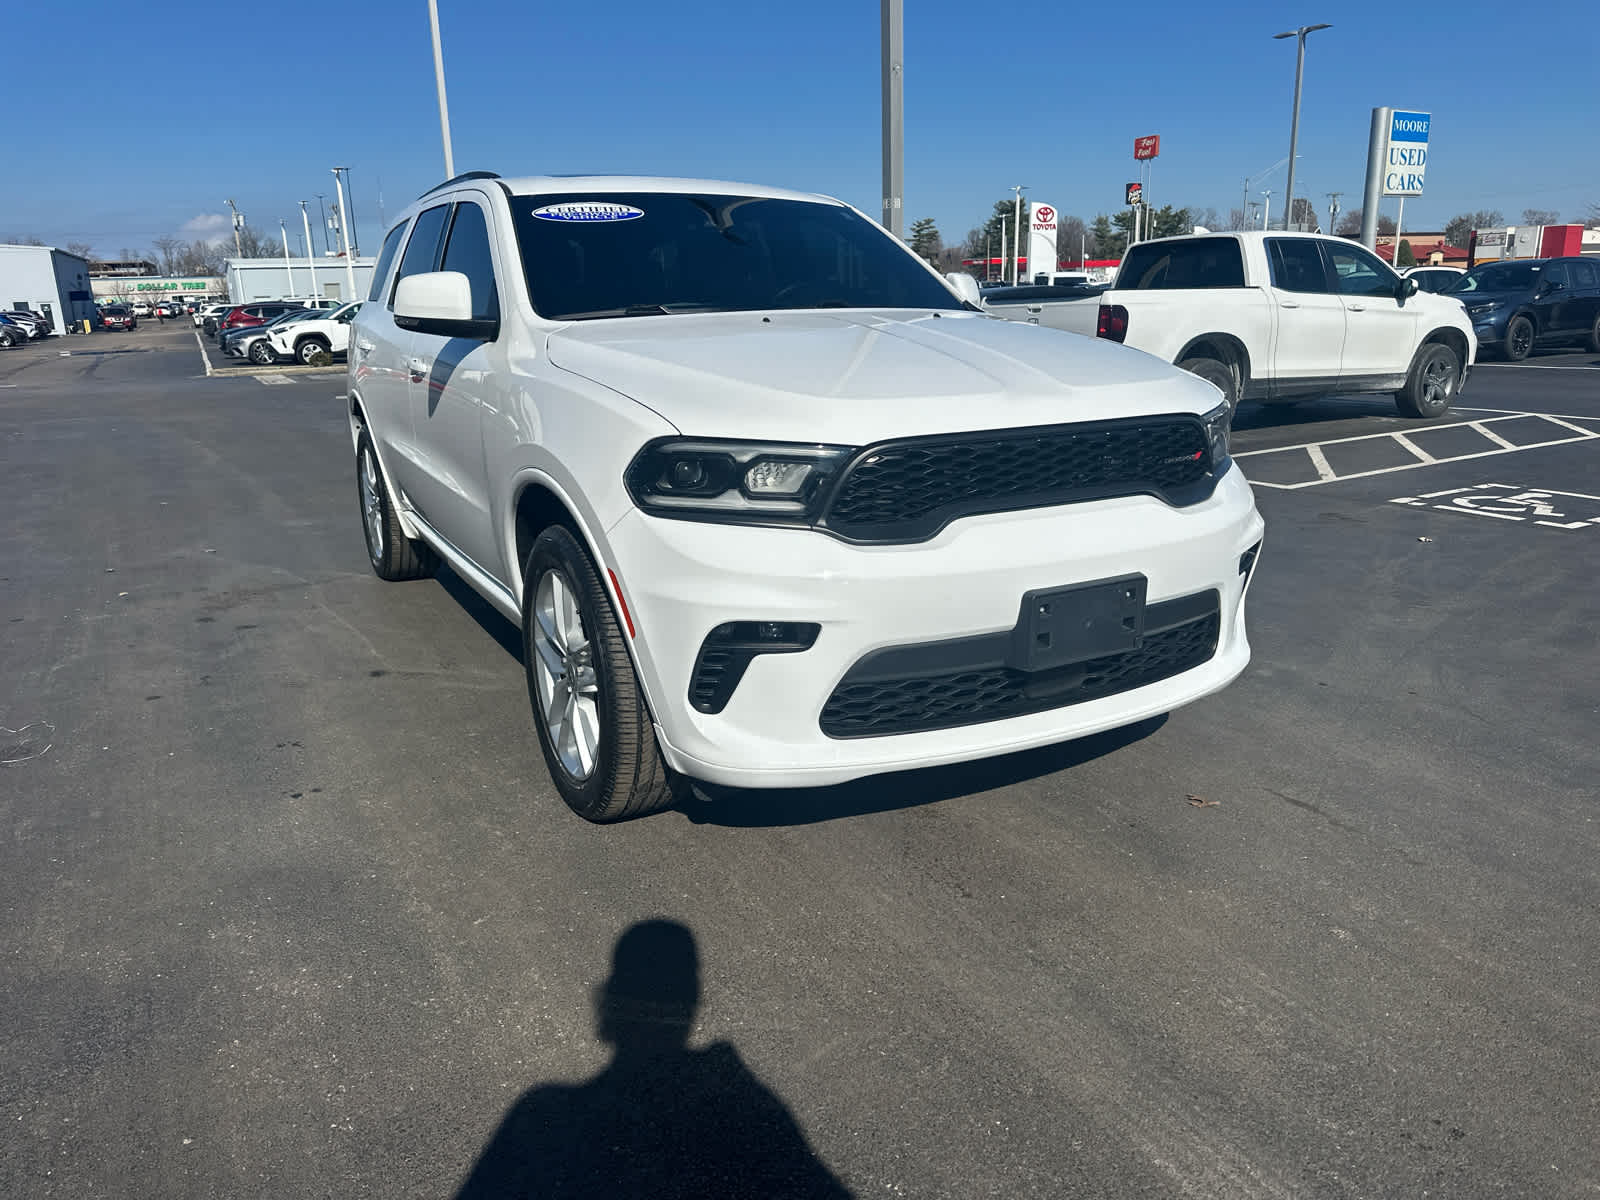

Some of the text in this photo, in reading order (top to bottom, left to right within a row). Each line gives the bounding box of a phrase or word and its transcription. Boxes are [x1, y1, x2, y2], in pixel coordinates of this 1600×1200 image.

[1393, 119, 1429, 133] MOORE
[1389, 147, 1427, 166] USED
[1386, 172, 1425, 191] CARS
[1032, 223, 1057, 231] TOYOTA
[136, 282, 206, 291] DOLLAR TREE
